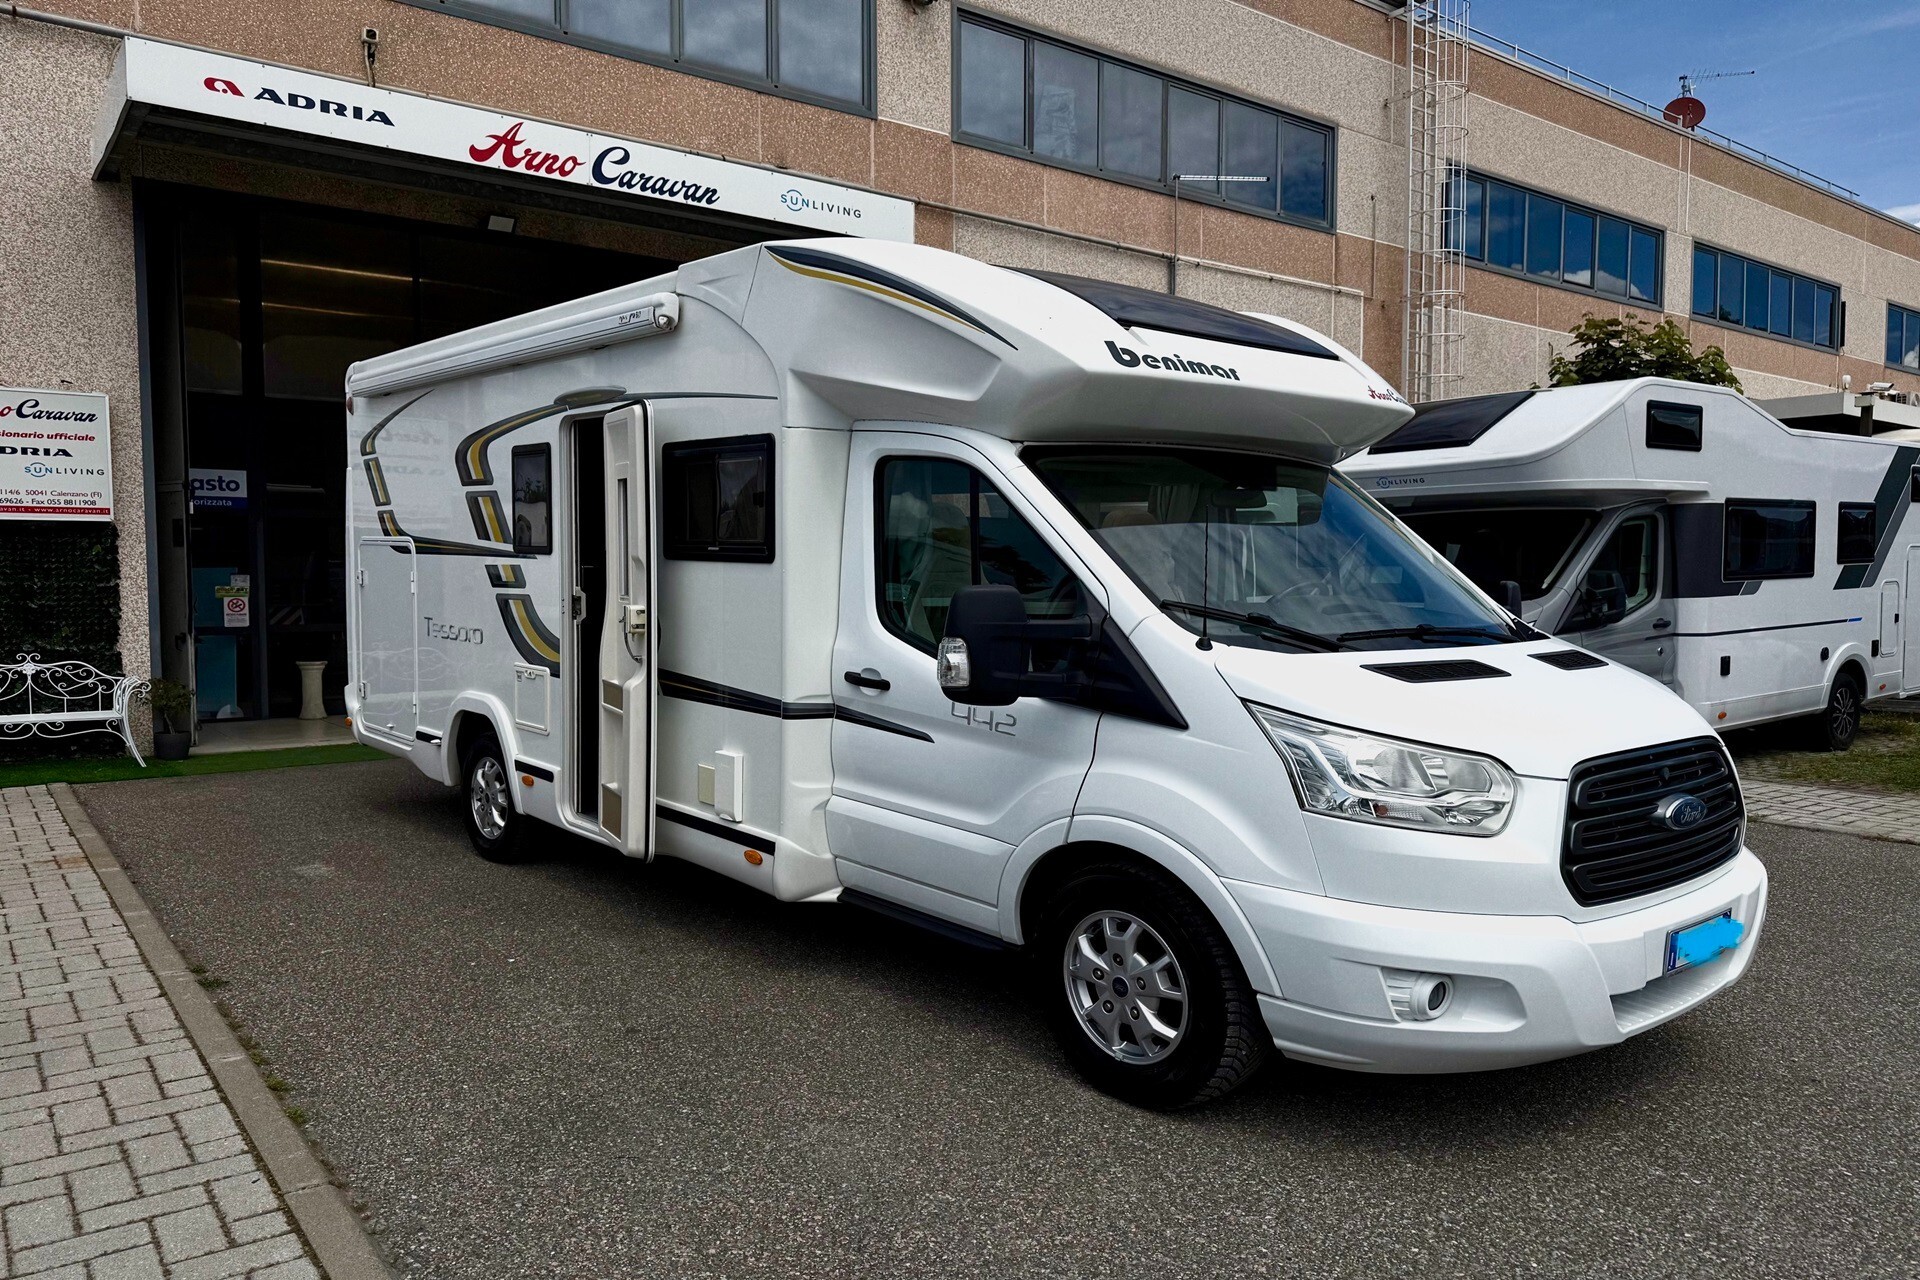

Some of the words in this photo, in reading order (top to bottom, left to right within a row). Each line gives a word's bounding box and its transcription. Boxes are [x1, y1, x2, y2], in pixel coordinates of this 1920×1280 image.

[254, 87, 395, 127] ADRIA
[468, 122, 587, 178] Arno
[591, 146, 720, 205] Caravan
[780, 191, 862, 219] SUNLIVING
[1103, 340, 1241, 381] benimar
[16, 398, 98, 422] Caravan
[47, 432, 96, 442] ufficiale
[24, 463, 105, 477] SUNLIVING
[50, 490, 89, 498] Calenzano
[1375, 477, 1426, 488] SUNLIVING
[46, 498, 62, 506] 055
[423, 616, 484, 645] Tessoro
[951, 702, 1017, 736] 442
[1680, 804, 1702, 824] Ford
